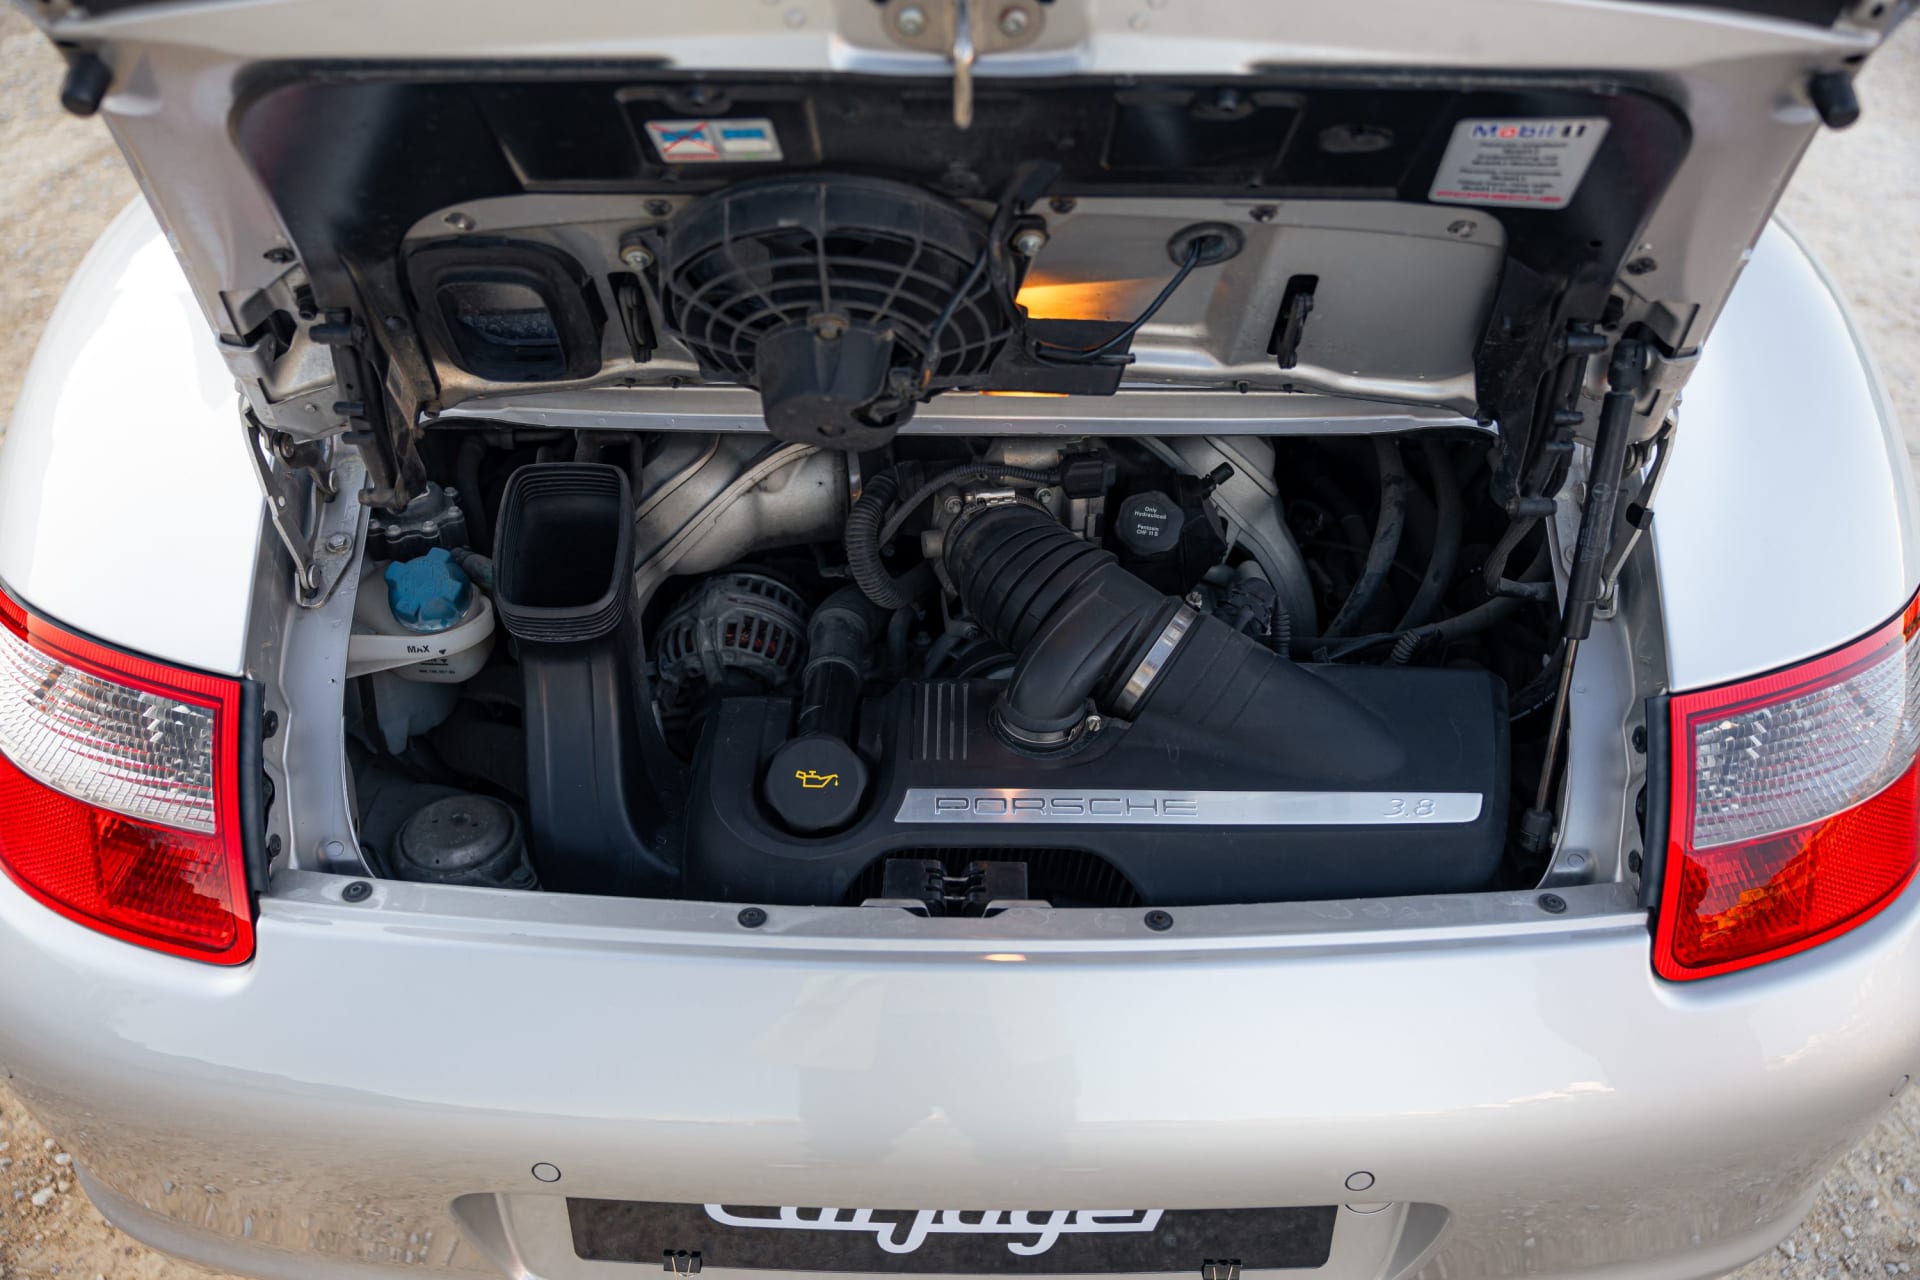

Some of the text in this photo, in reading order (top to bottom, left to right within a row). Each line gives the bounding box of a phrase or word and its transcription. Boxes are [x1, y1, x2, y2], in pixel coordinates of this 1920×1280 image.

[1472, 124, 1556, 138] Mobil
[935, 796, 1436, 818] PORSCHE 3.8
